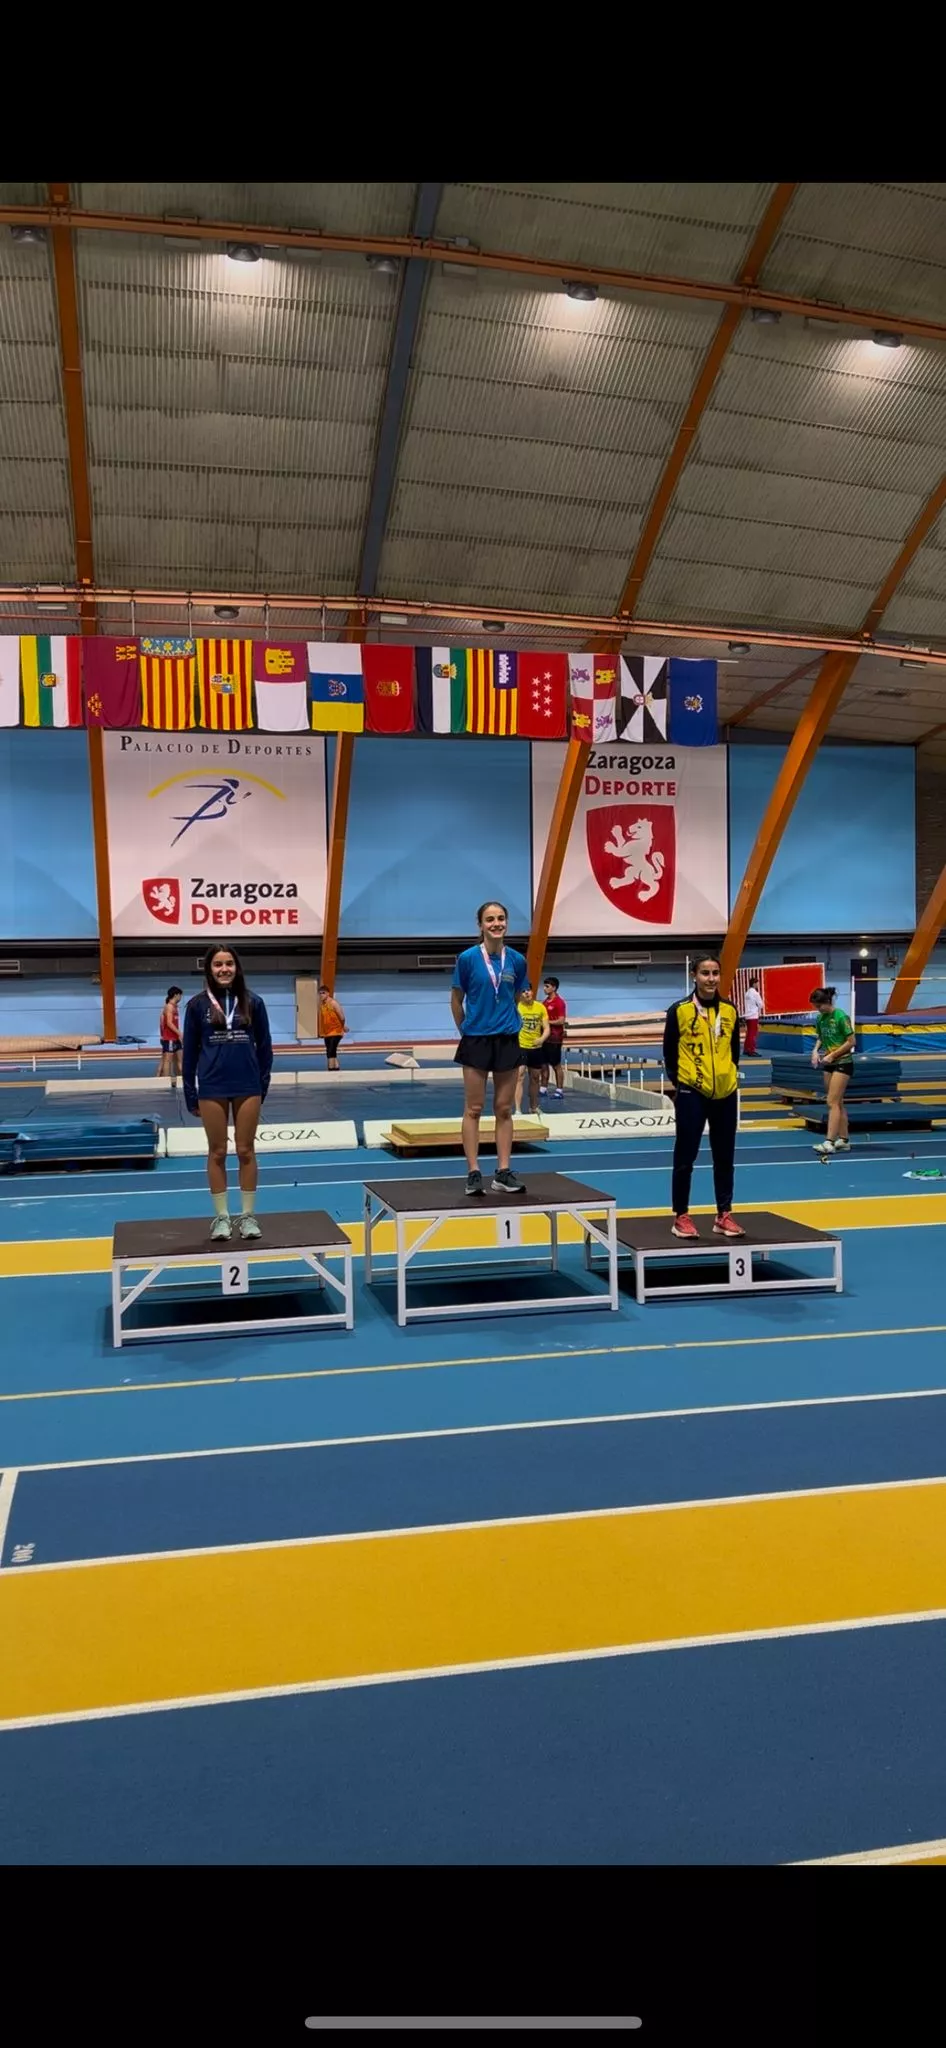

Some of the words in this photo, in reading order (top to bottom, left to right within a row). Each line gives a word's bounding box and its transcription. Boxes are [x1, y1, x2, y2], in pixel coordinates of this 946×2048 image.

[120, 735, 194, 753] PALACIO
[201, 744, 219, 753] DE
[228, 738, 312, 756] DEPORTES
[585, 751, 675, 775] Zaragoza
[585, 775, 676, 796] DEPORTE
[191, 878, 298, 904] Zaragoza
[191, 903, 298, 925] DEPORTE
[505, 1220, 510, 1239] 1
[229, 1266, 240, 1286] 2
[736, 1258, 745, 1276] 3
